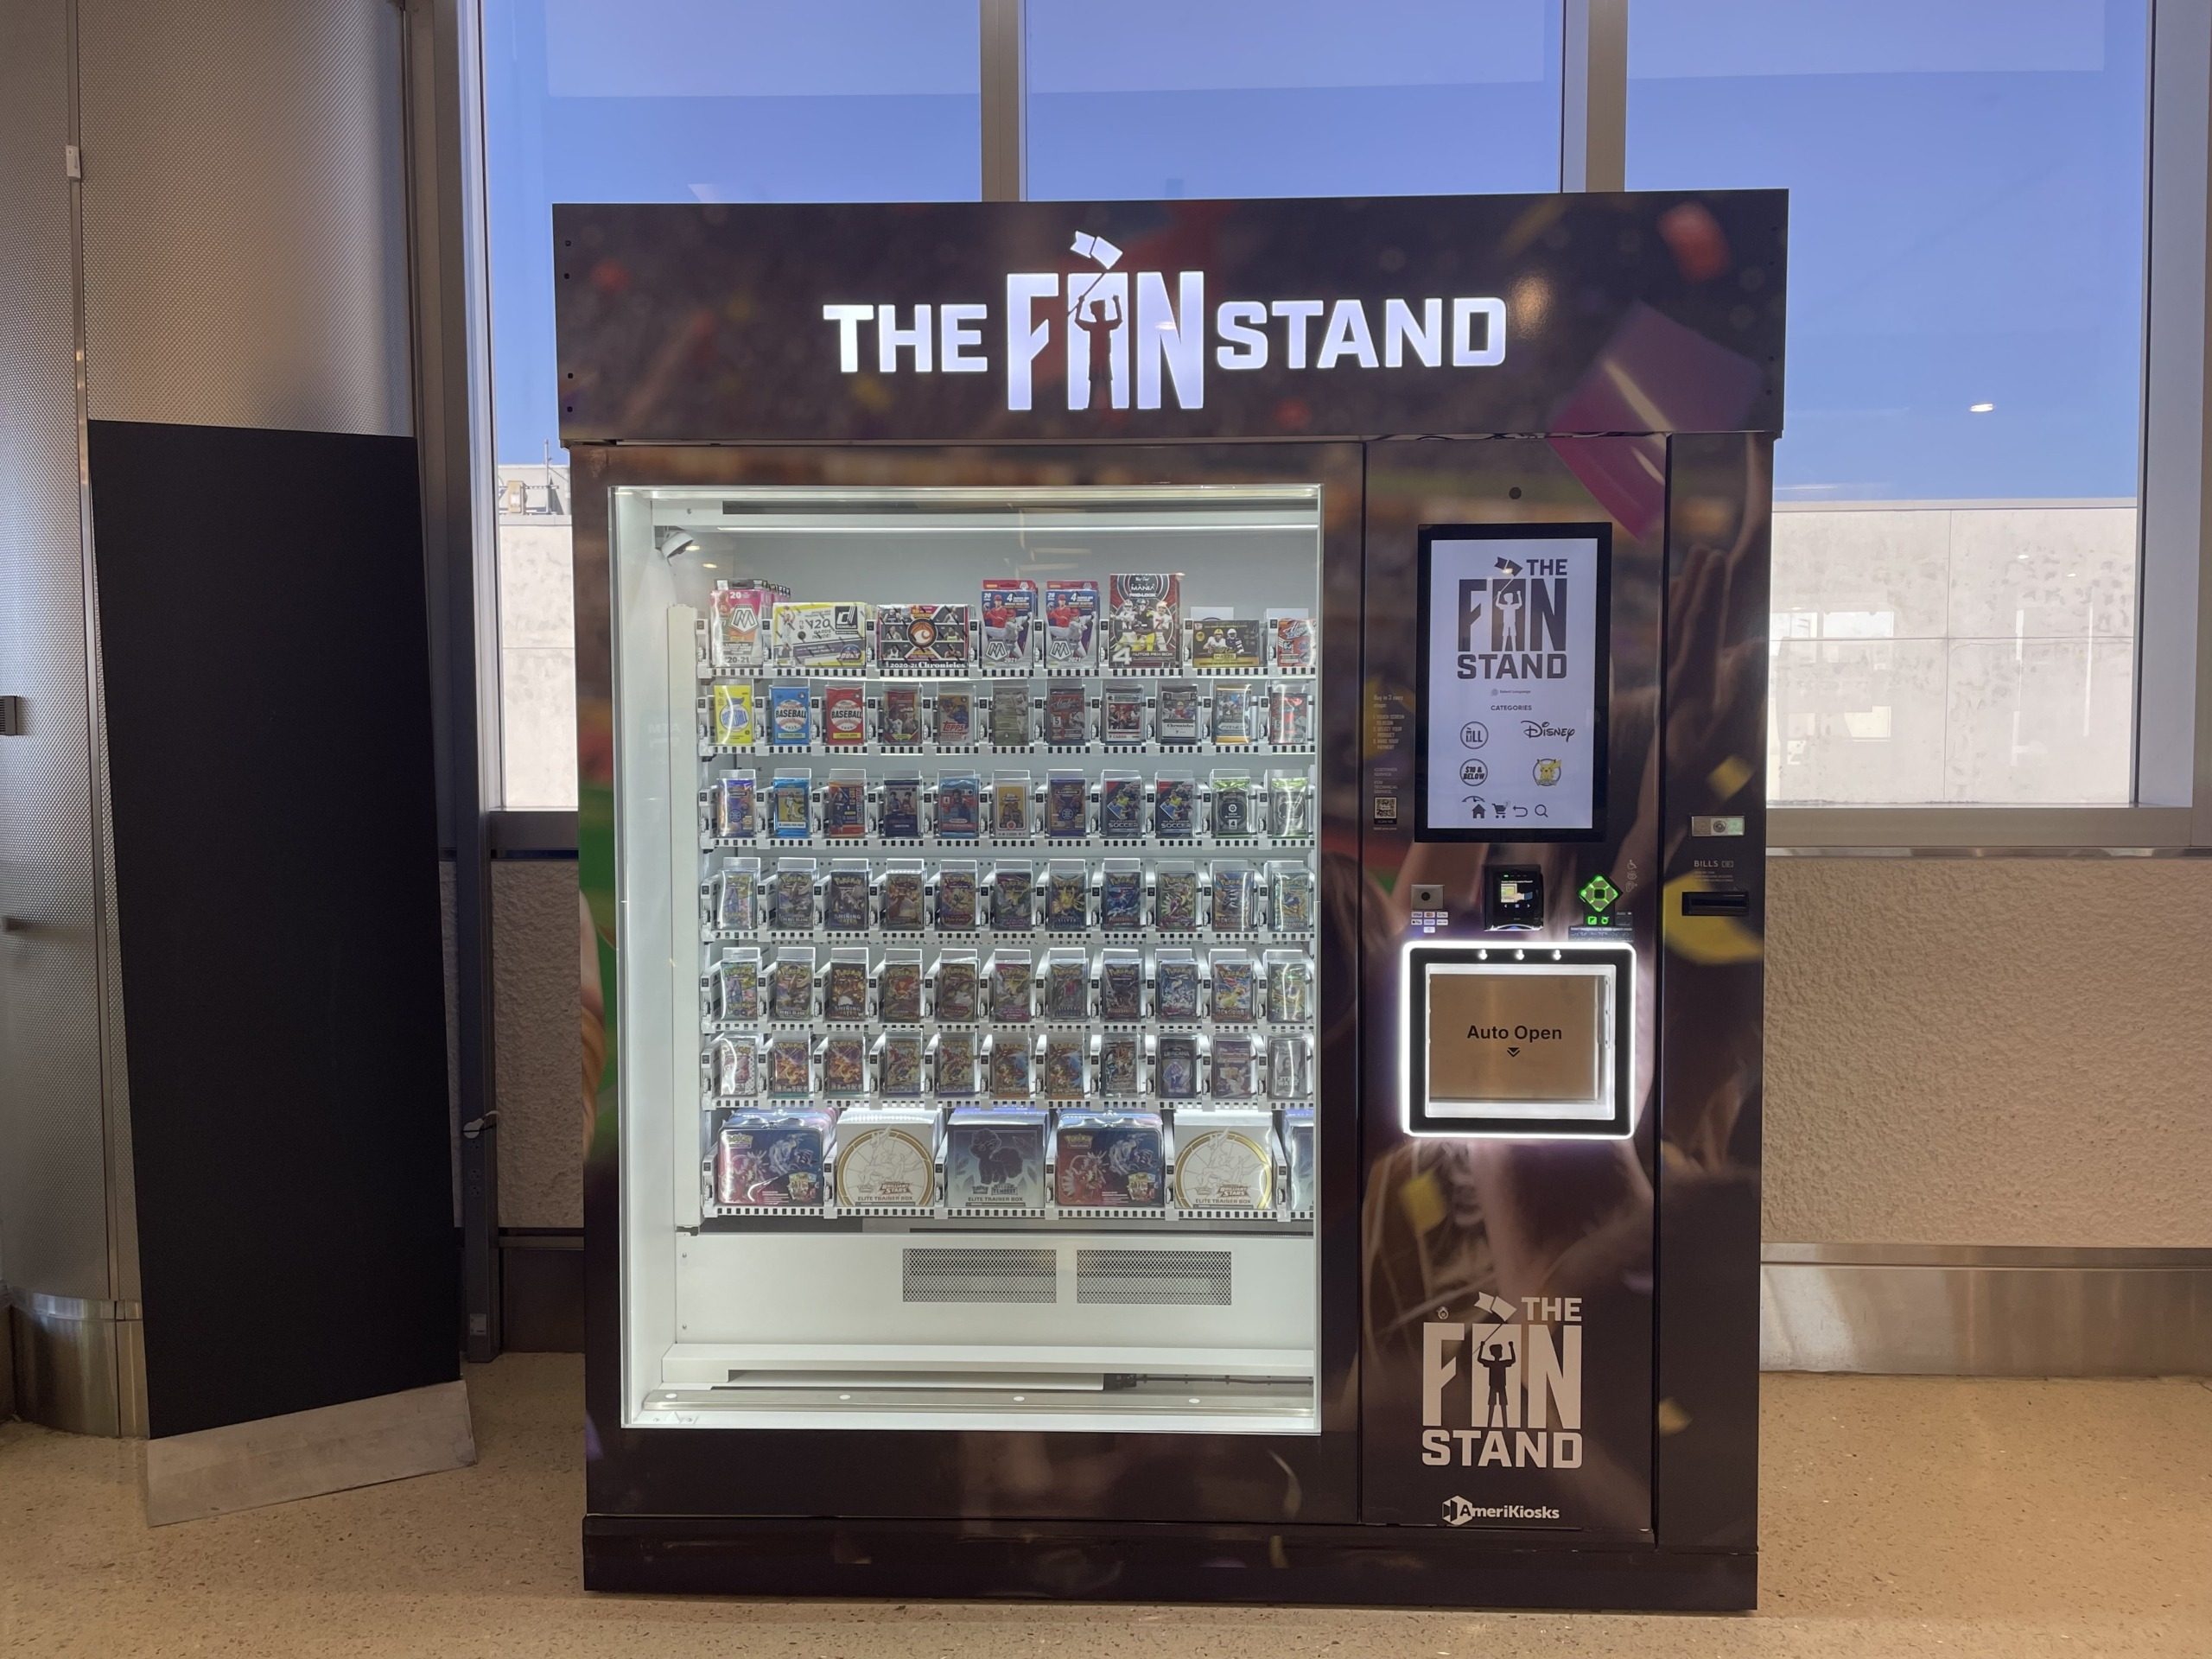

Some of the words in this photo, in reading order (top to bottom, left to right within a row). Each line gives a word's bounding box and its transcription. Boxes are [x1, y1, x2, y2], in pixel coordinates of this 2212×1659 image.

[823, 304, 988, 373] THE
[1007, 270, 1205, 411] FAN
[1217, 297, 1507, 370] STAND
[1526, 558, 1568, 576] THE
[1007, 593, 1013, 602] 4
[1457, 578, 1568, 652] FAN
[1112, 646, 1132, 665] 4
[1457, 653, 1567, 680] STAND
[775, 709, 807, 719] BASEBALL
[831, 709, 862, 719] BASEBALL
[1466, 1024, 1509, 1039] Auto
[1514, 1024, 1562, 1043] Open
[1520, 1296, 1582, 1322] THE
[1422, 1322, 1583, 1430] FAN
[1421, 1429, 1583, 1469] STAND
[1460, 1503, 1560, 1519] AmeriKiosks
